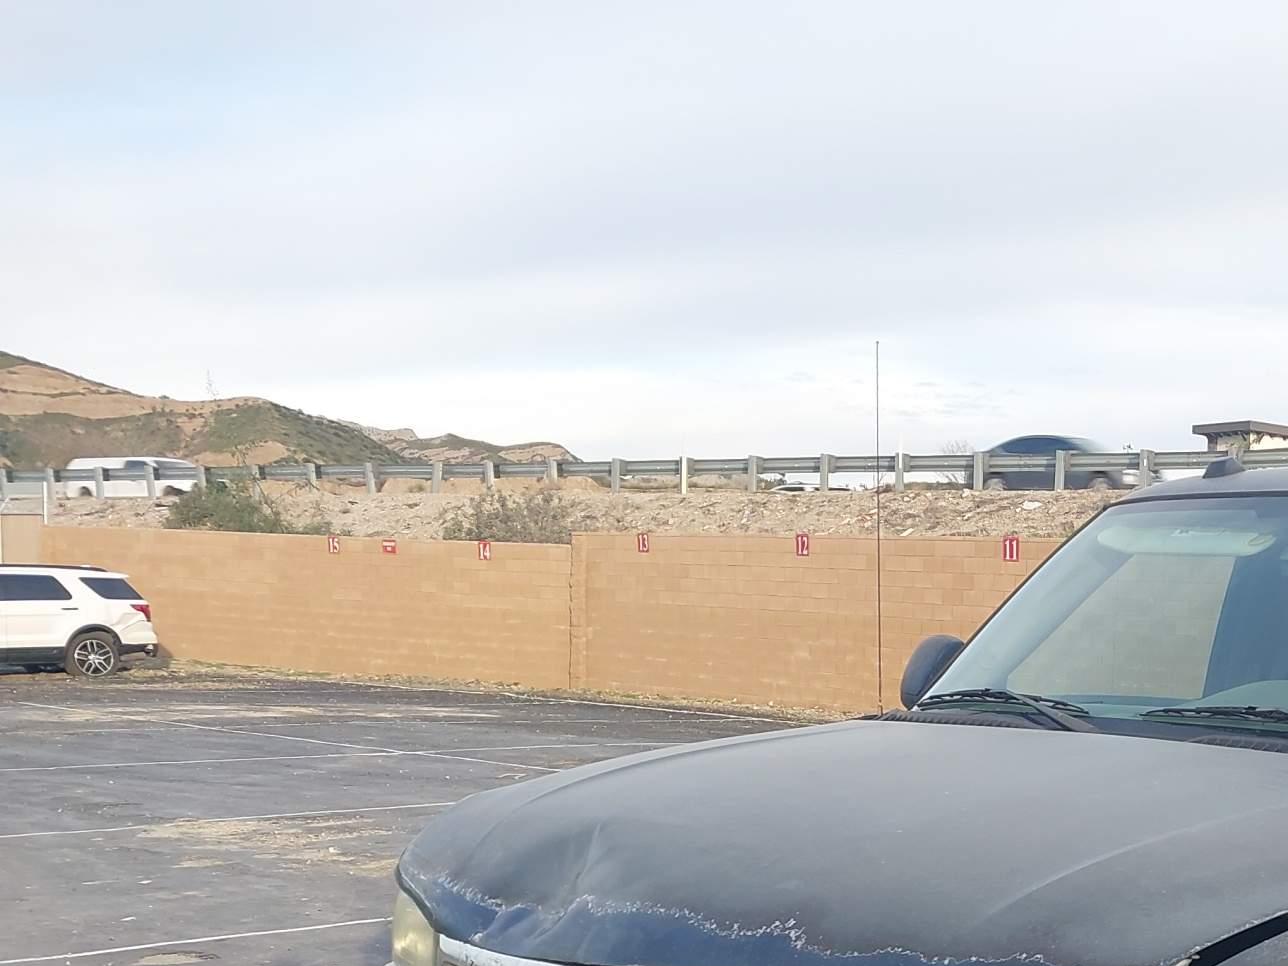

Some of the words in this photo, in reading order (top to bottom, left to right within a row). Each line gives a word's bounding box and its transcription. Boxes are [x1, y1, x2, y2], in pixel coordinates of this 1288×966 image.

[328, 537, 339, 553] 15
[638, 534, 649, 551] 13
[797, 536, 808, 555] 12
[1004, 539, 1017, 561] 11
[479, 543, 490, 560] 14
